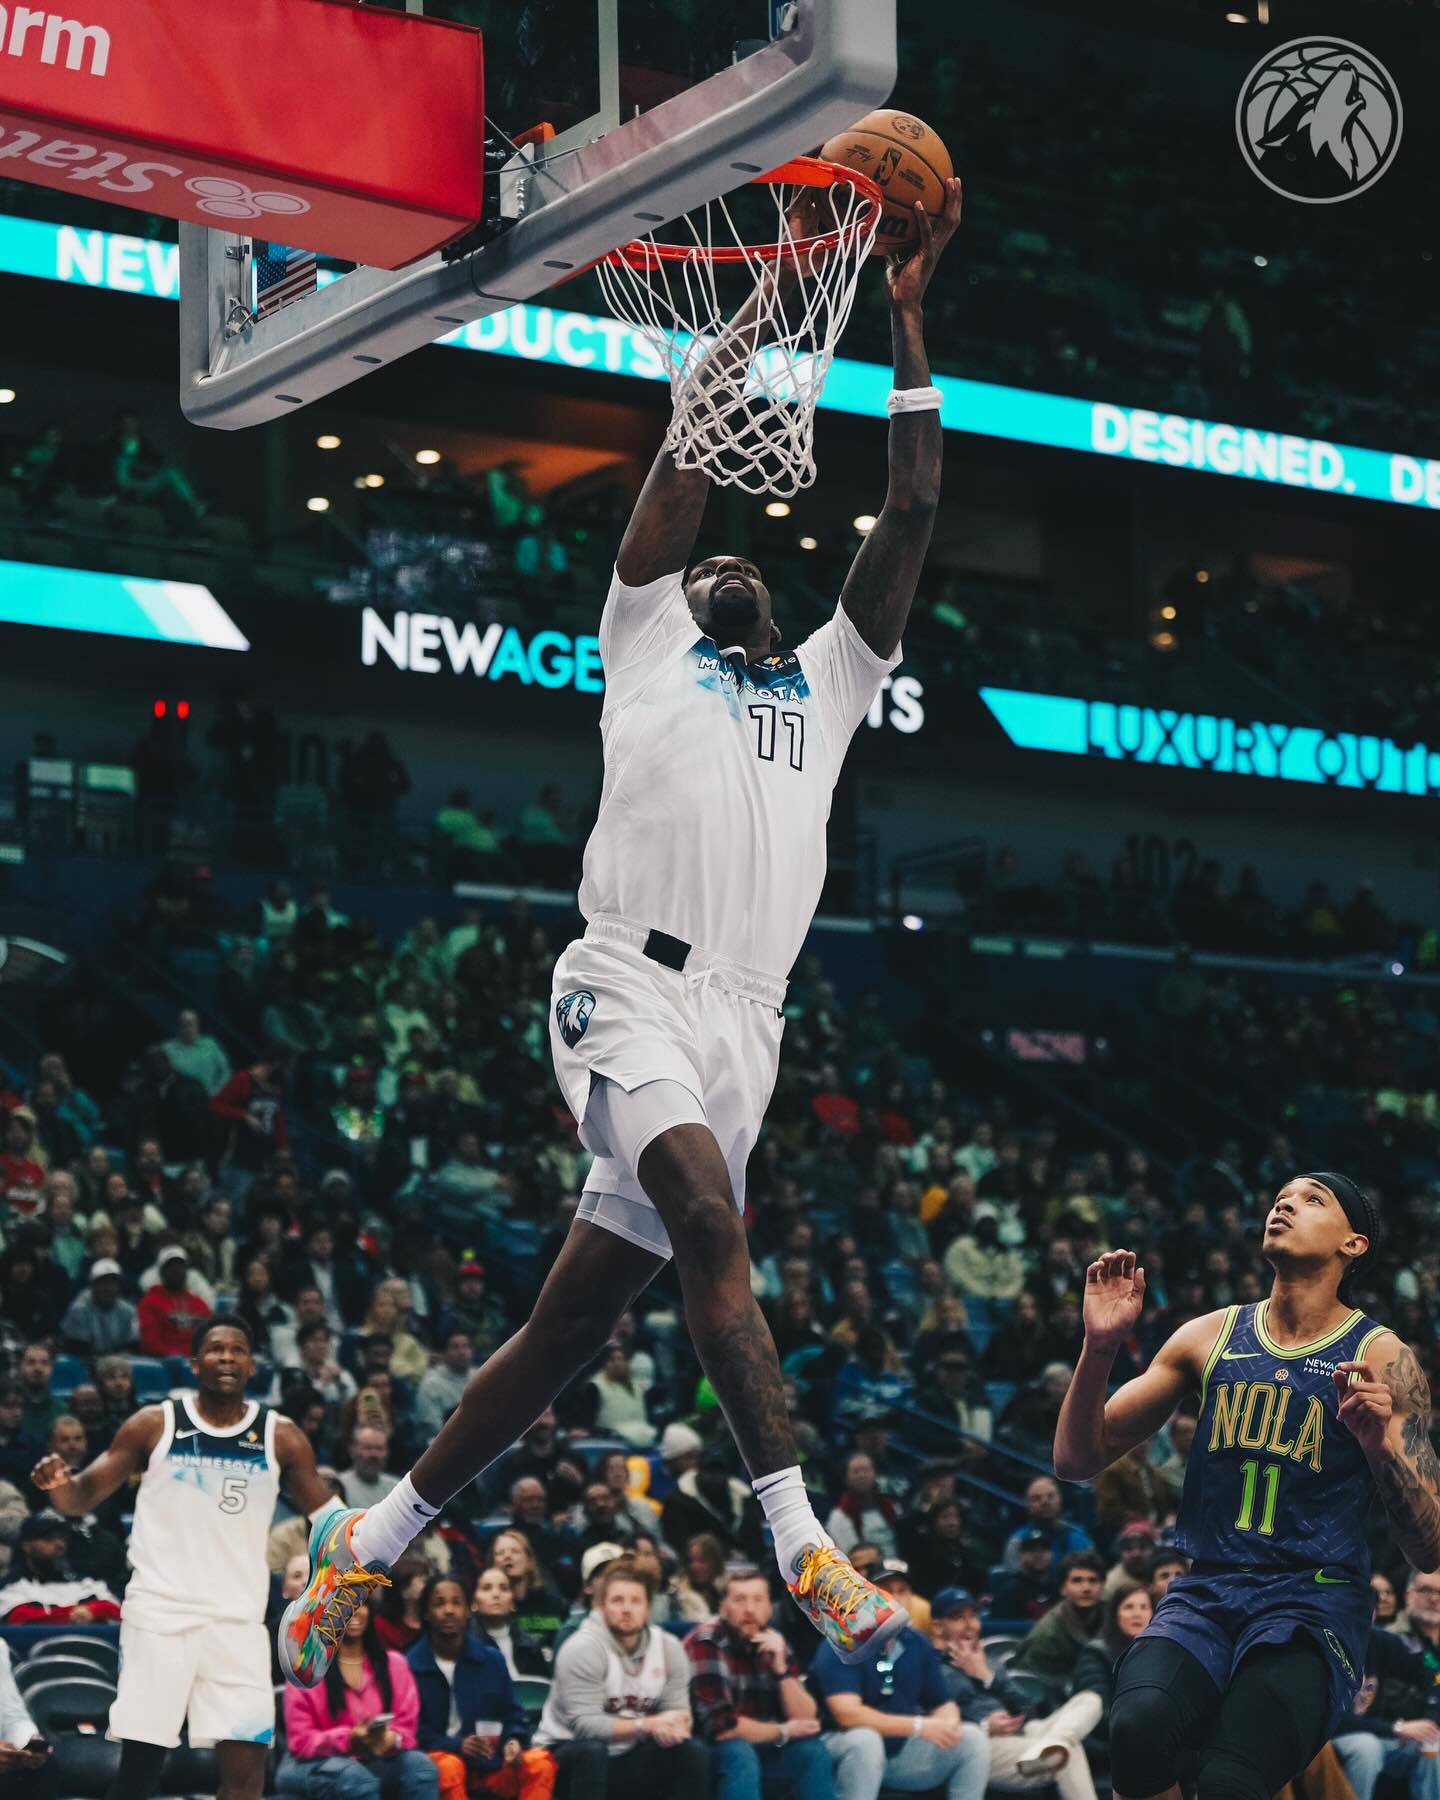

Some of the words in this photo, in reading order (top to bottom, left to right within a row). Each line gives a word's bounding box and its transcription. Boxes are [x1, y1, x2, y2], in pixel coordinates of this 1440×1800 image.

[0, 5, 111, 77] rm
[0, 126, 184, 193] Stat
[445, 303, 666, 379] DUCTS
[1091, 402, 1357, 494] DESIGNED.
[361, 606, 605, 694] NEWAGE
[698, 656, 803, 704] MNSOTA
[748, 703, 804, 771] 11
[1087, 700, 1294, 778] LUXURY
[1314, 728, 1440, 800] OUT
[1208, 1381, 1324, 1473] NOLA
[218, 1477, 248, 1515] 5
[1235, 1458, 1281, 1536] 11
